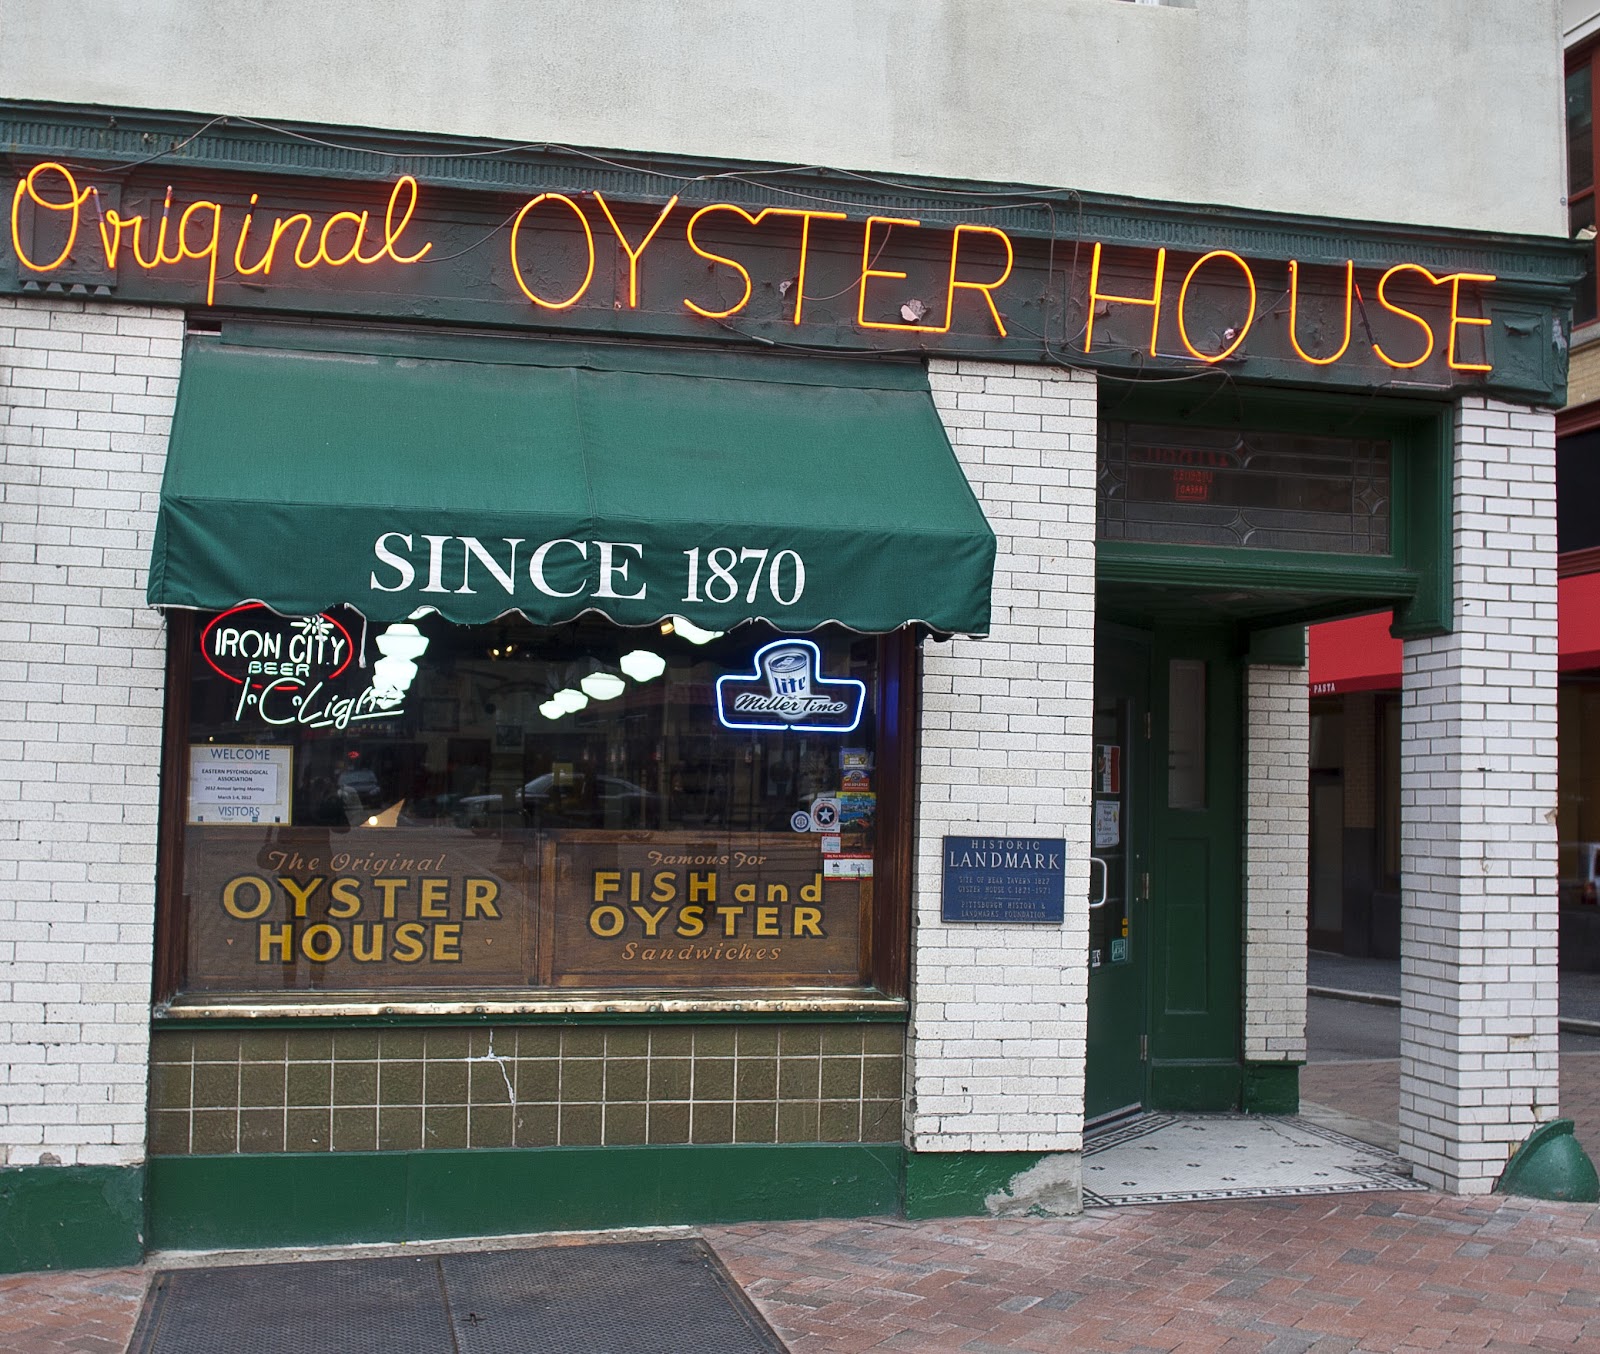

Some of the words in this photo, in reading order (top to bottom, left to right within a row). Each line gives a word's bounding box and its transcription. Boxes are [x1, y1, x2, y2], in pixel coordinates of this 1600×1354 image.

[11, 162, 432, 306] Original
[510, 190, 1014, 337] OYSTER
[1085, 242, 1497, 371] HOUSE
[370, 532, 647, 600] SINCE
[681, 546, 806, 605] 1870
[215, 628, 282, 659] IRON
[289, 634, 345, 666] CITY
[248, 661, 310, 677] BEER
[1313, 682, 1336, 694] PASTA
[735, 694, 799, 712] Miller
[798, 697, 846, 713] Time
[210, 748, 270, 760] WELCOME
[218, 806, 260, 817] VISITORS
[971, 839, 1040, 850] HISTORIC
[268, 851, 320, 872] The
[330, 851, 447, 876] Original
[647, 851, 729, 867] Famous
[733, 851, 767, 868] For
[949, 851, 1060, 870] LANDMARK
[594, 871, 717, 902] FISH
[734, 873, 822, 903] and
[976, 876, 985, 884] OF
[222, 875, 500, 919] OYSTER
[985, 886, 1005, 894] HOUSE
[961, 901, 1003, 909] PITTSBURGH
[1007, 901, 1036, 909] HISTORY
[961, 910, 999, 918] LANDMARKS
[1004, 911, 1046, 919] FOUNDATION
[589, 906, 825, 937] OYSTER
[258, 922, 462, 962] HOUSE
[621, 942, 782, 961] Sandwiches
